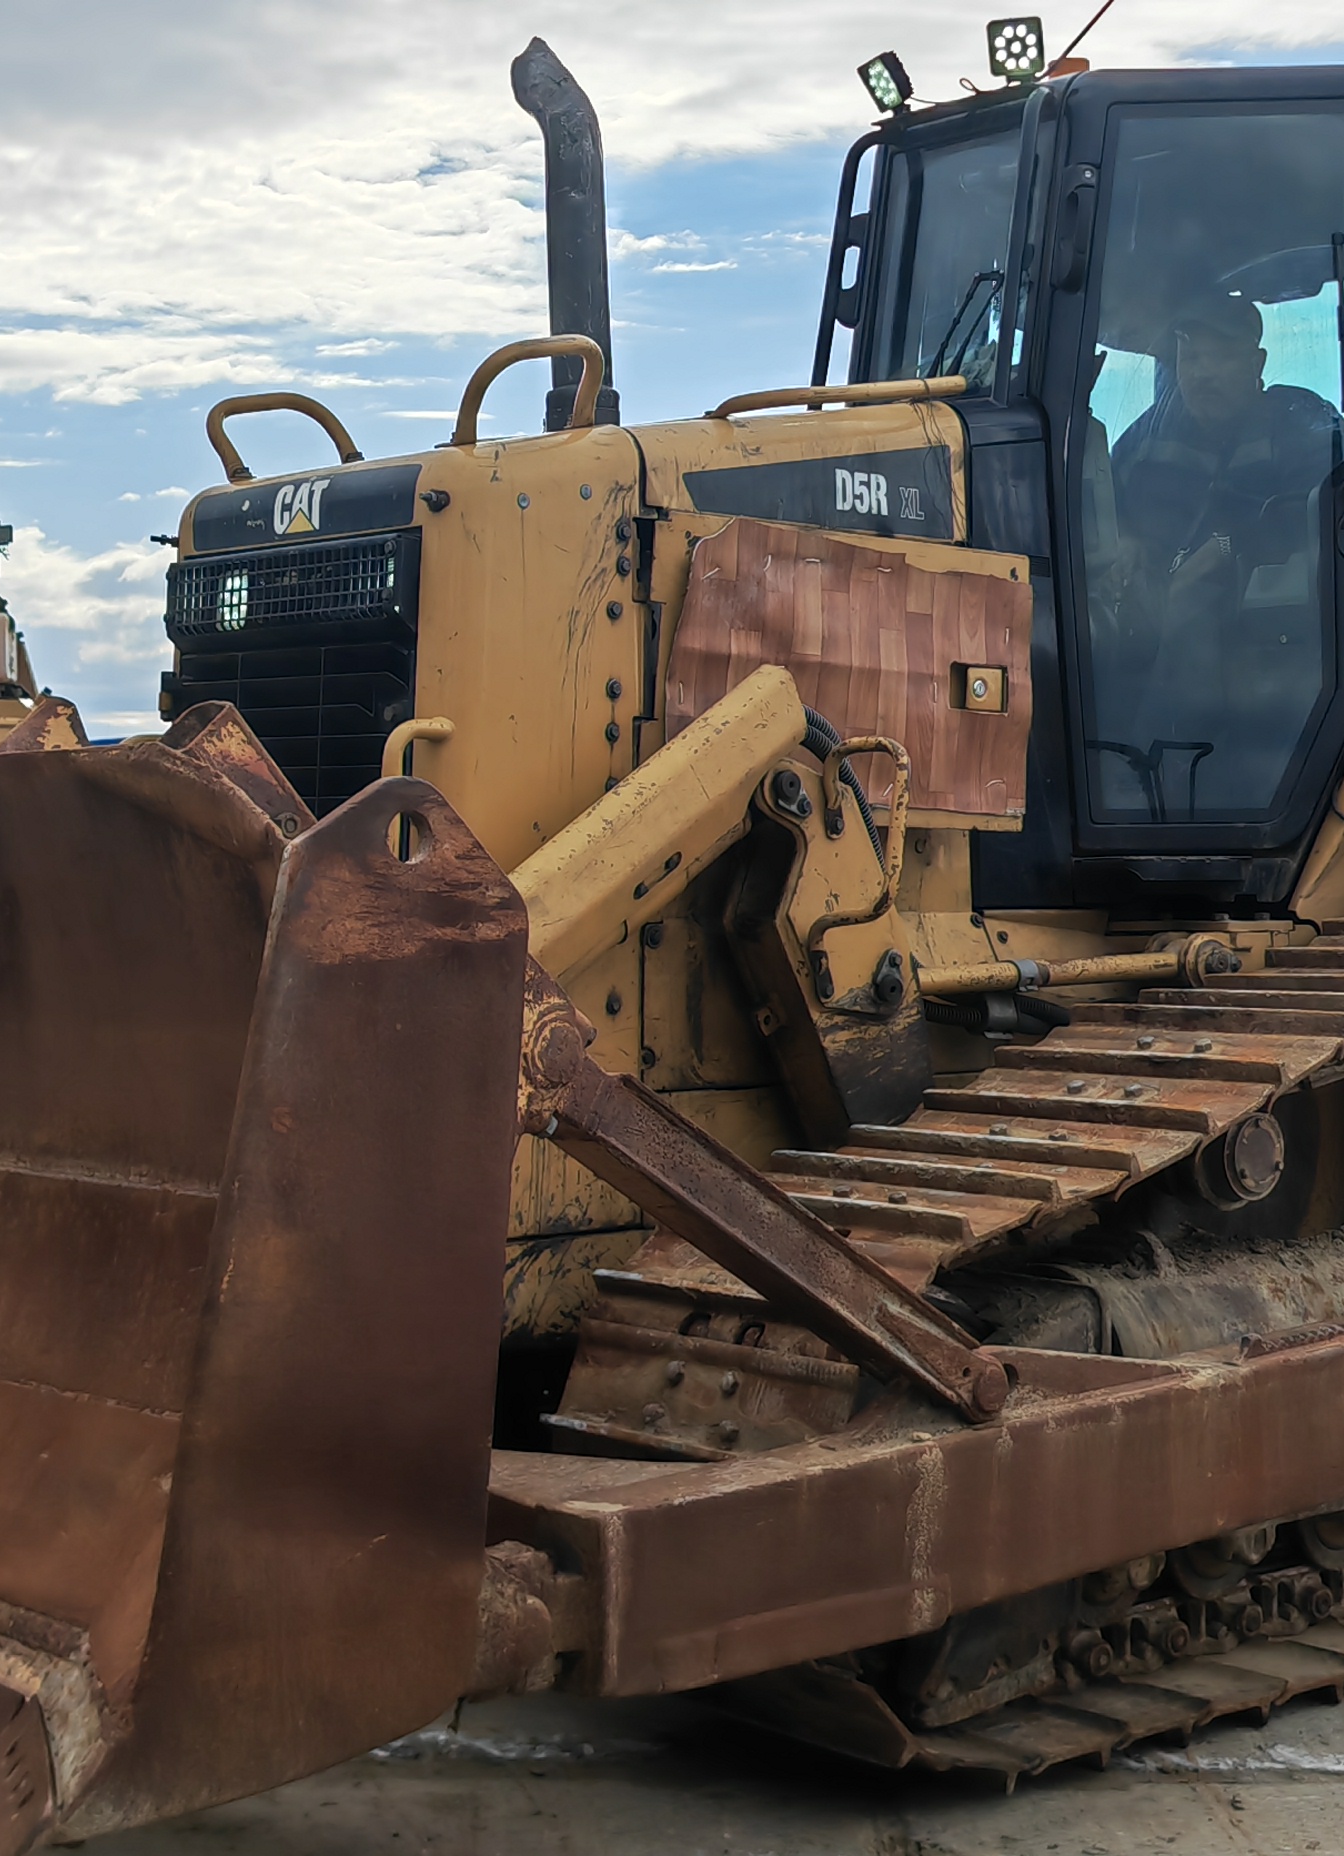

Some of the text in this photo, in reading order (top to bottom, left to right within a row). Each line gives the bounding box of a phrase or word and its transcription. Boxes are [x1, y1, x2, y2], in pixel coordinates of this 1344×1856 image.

[273, 479, 332, 535] CAT
[834, 467, 925, 520] D5R XL
